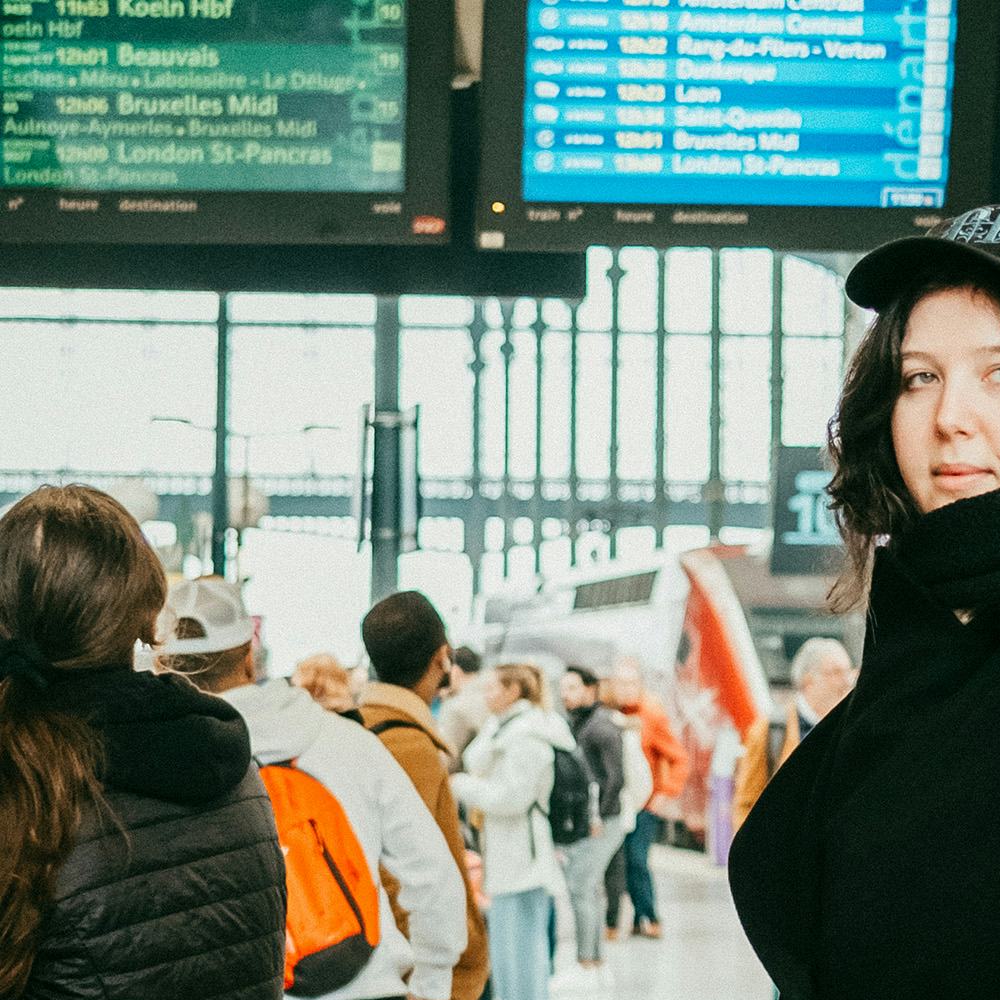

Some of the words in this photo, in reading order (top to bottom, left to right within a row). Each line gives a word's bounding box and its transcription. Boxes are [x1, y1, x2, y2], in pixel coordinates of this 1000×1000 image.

[117, 43, 219, 67] Beauvais
[884, 0, 928, 180] départ
[117, 92, 223, 116] Bruxelles
[227, 94, 278, 116] Midi
[189, 119, 272, 137] Bruxelles
[118, 141, 204, 164] London
[210, 140, 332, 165] St-Pancras
[3, 166, 73, 185] London
[119, 198, 198, 212] destination
